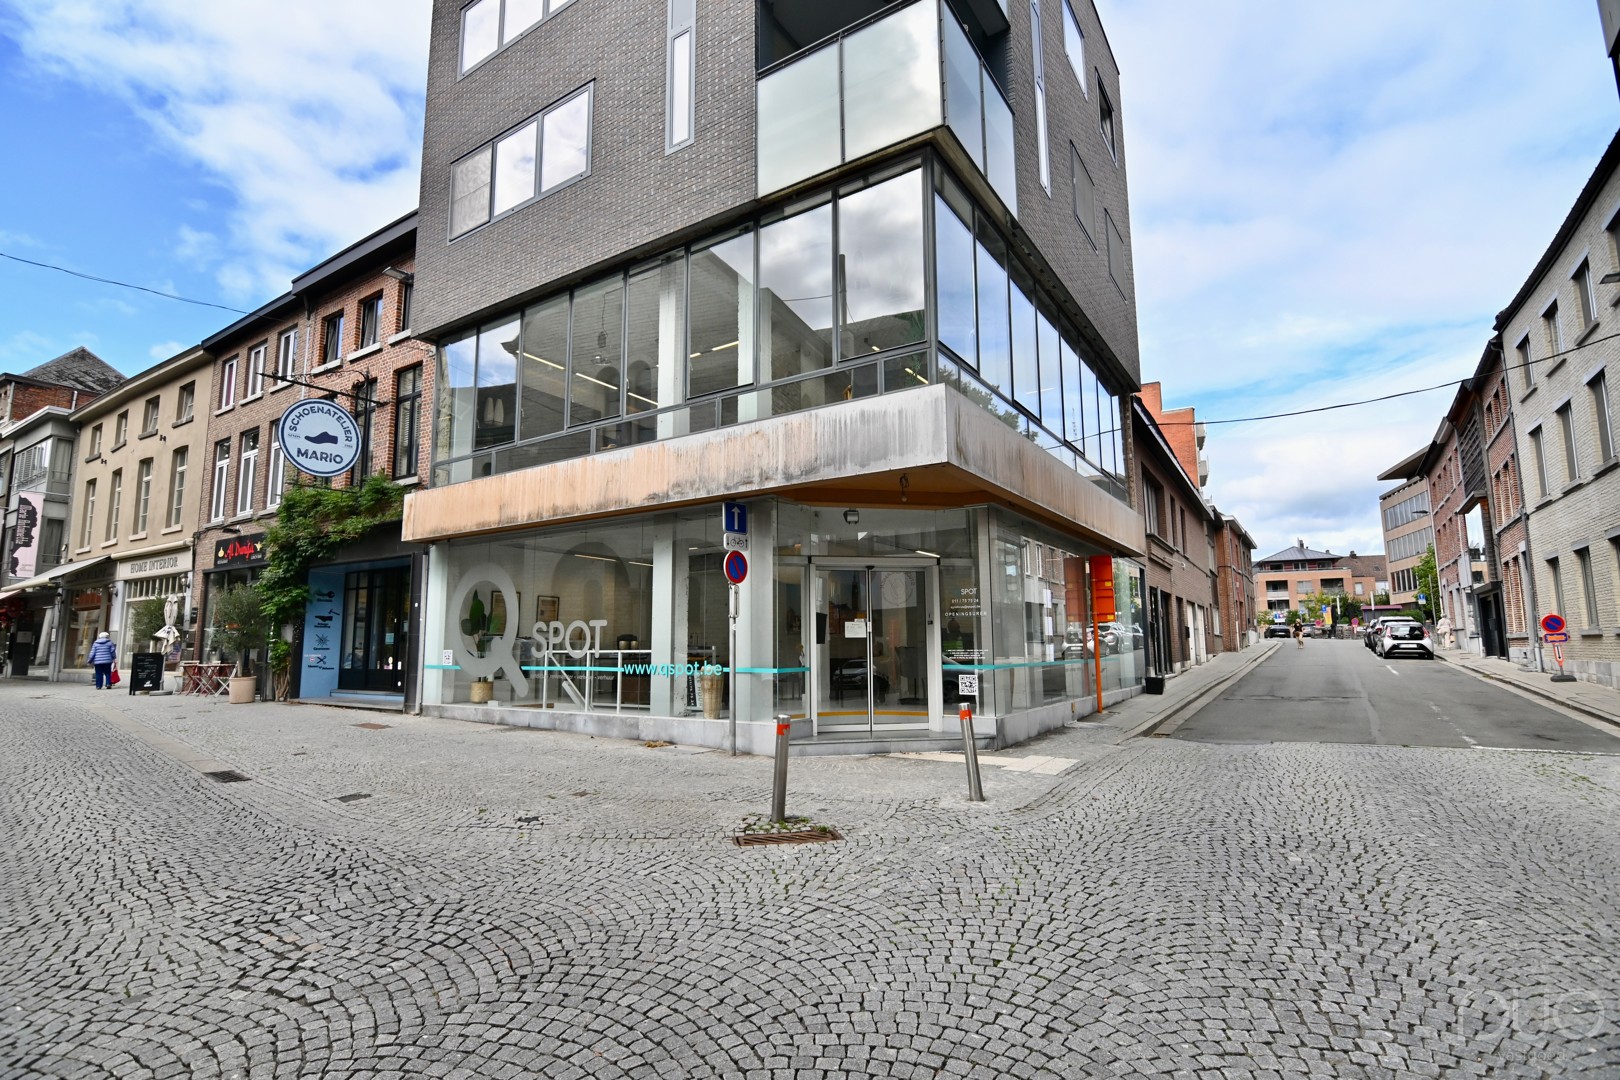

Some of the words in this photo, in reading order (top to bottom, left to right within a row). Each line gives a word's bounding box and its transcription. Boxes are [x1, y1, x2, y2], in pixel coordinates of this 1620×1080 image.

[289, 406, 352, 442] SCHOENATELIER
[296, 447, 343, 464] MARIO
[130, 561, 148, 574] HOME
[148, 556, 179, 571] INTERIOR
[960, 587, 977, 595] SPOT
[451, 563, 528, 698] Q
[531, 619, 607, 659] SPOT
[624, 660, 722, 678] www.qspot.be
